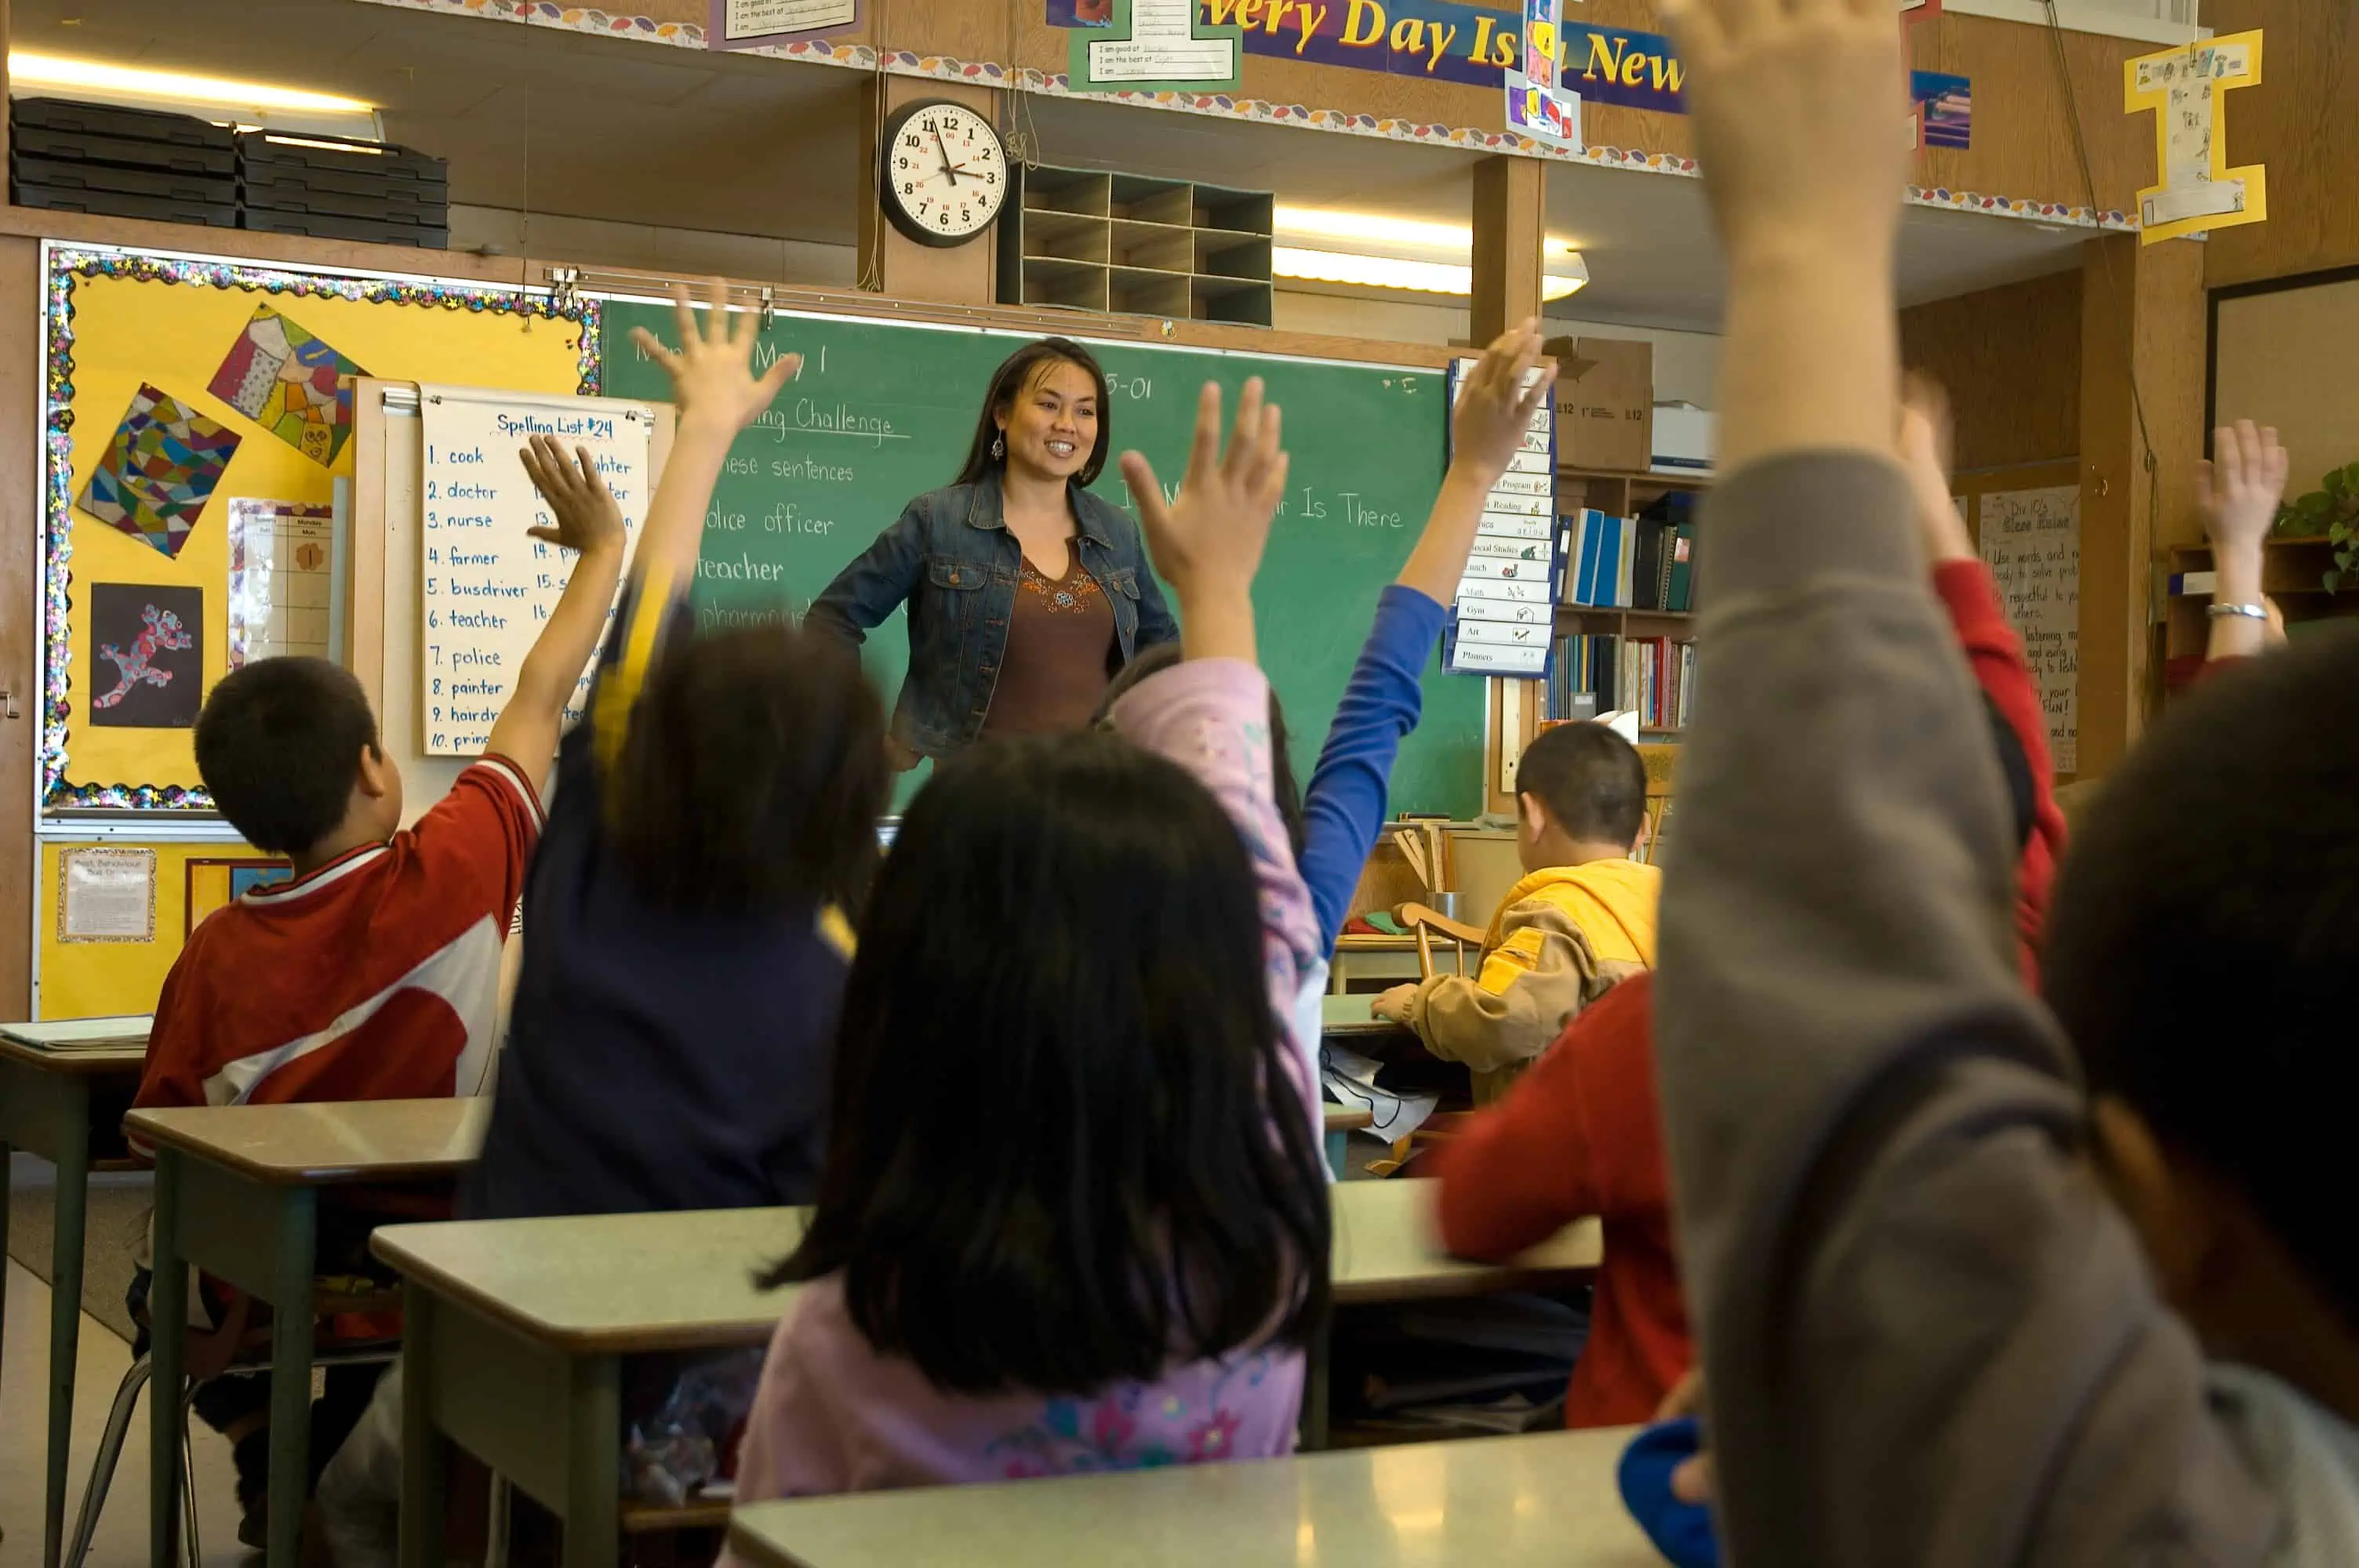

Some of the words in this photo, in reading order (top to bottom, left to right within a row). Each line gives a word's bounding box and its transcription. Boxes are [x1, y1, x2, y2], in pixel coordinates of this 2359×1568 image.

[751, 10, 761, 19] the
[761, 9, 776, 18] best
[1115, 45, 1132, 56] good
[1198, 0, 1327, 54] very
[1338, 0, 1456, 72] Day
[1467, 16, 1518, 68] Is
[1581, 32, 1687, 94] New
[921, 119, 936, 132] 11
[943, 117, 958, 130] 12
[905, 134, 920, 148] 10
[968, 128, 975, 140] 1
[981, 147, 990, 161] 2
[900, 157, 908, 169] 9
[986, 172, 995, 184] 3
[904, 182, 914, 195] 8
[919, 202, 928, 215] 7
[978, 195, 987, 208] 4
[940, 212, 949, 225] 6
[961, 209, 971, 223] 5
[820, 345, 827, 373] 1
[1563, 403, 1575, 414] 12
[1632, 409, 1643, 421] 12
[497, 413, 554, 437] Spelling
[558, 417, 584, 434] List
[795, 397, 894, 450] Challenge
[429, 445, 440, 464] 1.
[449, 446, 484, 463] cook
[722, 456, 759, 475] ese
[772, 452, 854, 481] sentences
[427, 481, 442, 500] 2.
[447, 481, 498, 499] doctor
[1503, 480, 1532, 491] Program
[1300, 486, 1327, 518] Is
[1337, 492, 1405, 528] There
[1494, 500, 1522, 510] Reading
[427, 511, 443, 528] 3.
[447, 514, 493, 528] nurse
[535, 513, 553, 525] 13.
[706, 499, 746, 531] olice
[764, 502, 834, 535] officer
[428, 546, 445, 566] 4.
[449, 545, 500, 567] farmer
[533, 543, 552, 559] 14.
[1493, 545, 1518, 554] Studies
[1994, 549, 2012, 565] Use
[2046, 542, 2065, 560] and
[427, 577, 444, 595] 5.
[451, 577, 529, 598] busdriver
[536, 574, 554, 589] 15.
[1465, 587, 1485, 597] Math
[2055, 586, 2063, 601] to
[1467, 606, 1485, 615] Gym
[428, 609, 443, 628] 6.
[449, 608, 507, 629] teacher
[1467, 626, 1479, 636] Art
[430, 645, 443, 666] 7.
[452, 647, 502, 672] police
[1463, 651, 1493, 662] Planners
[2026, 644, 2042, 659] and
[2047, 659, 2055, 673] to
[432, 678, 444, 697] 8.
[451, 678, 503, 699] painter
[2048, 688, 2070, 704] your
[432, 708, 443, 722] 9.
[450, 706, 498, 722] hairdr
[2050, 720, 2065, 738] and
[431, 733, 447, 748] 10.
